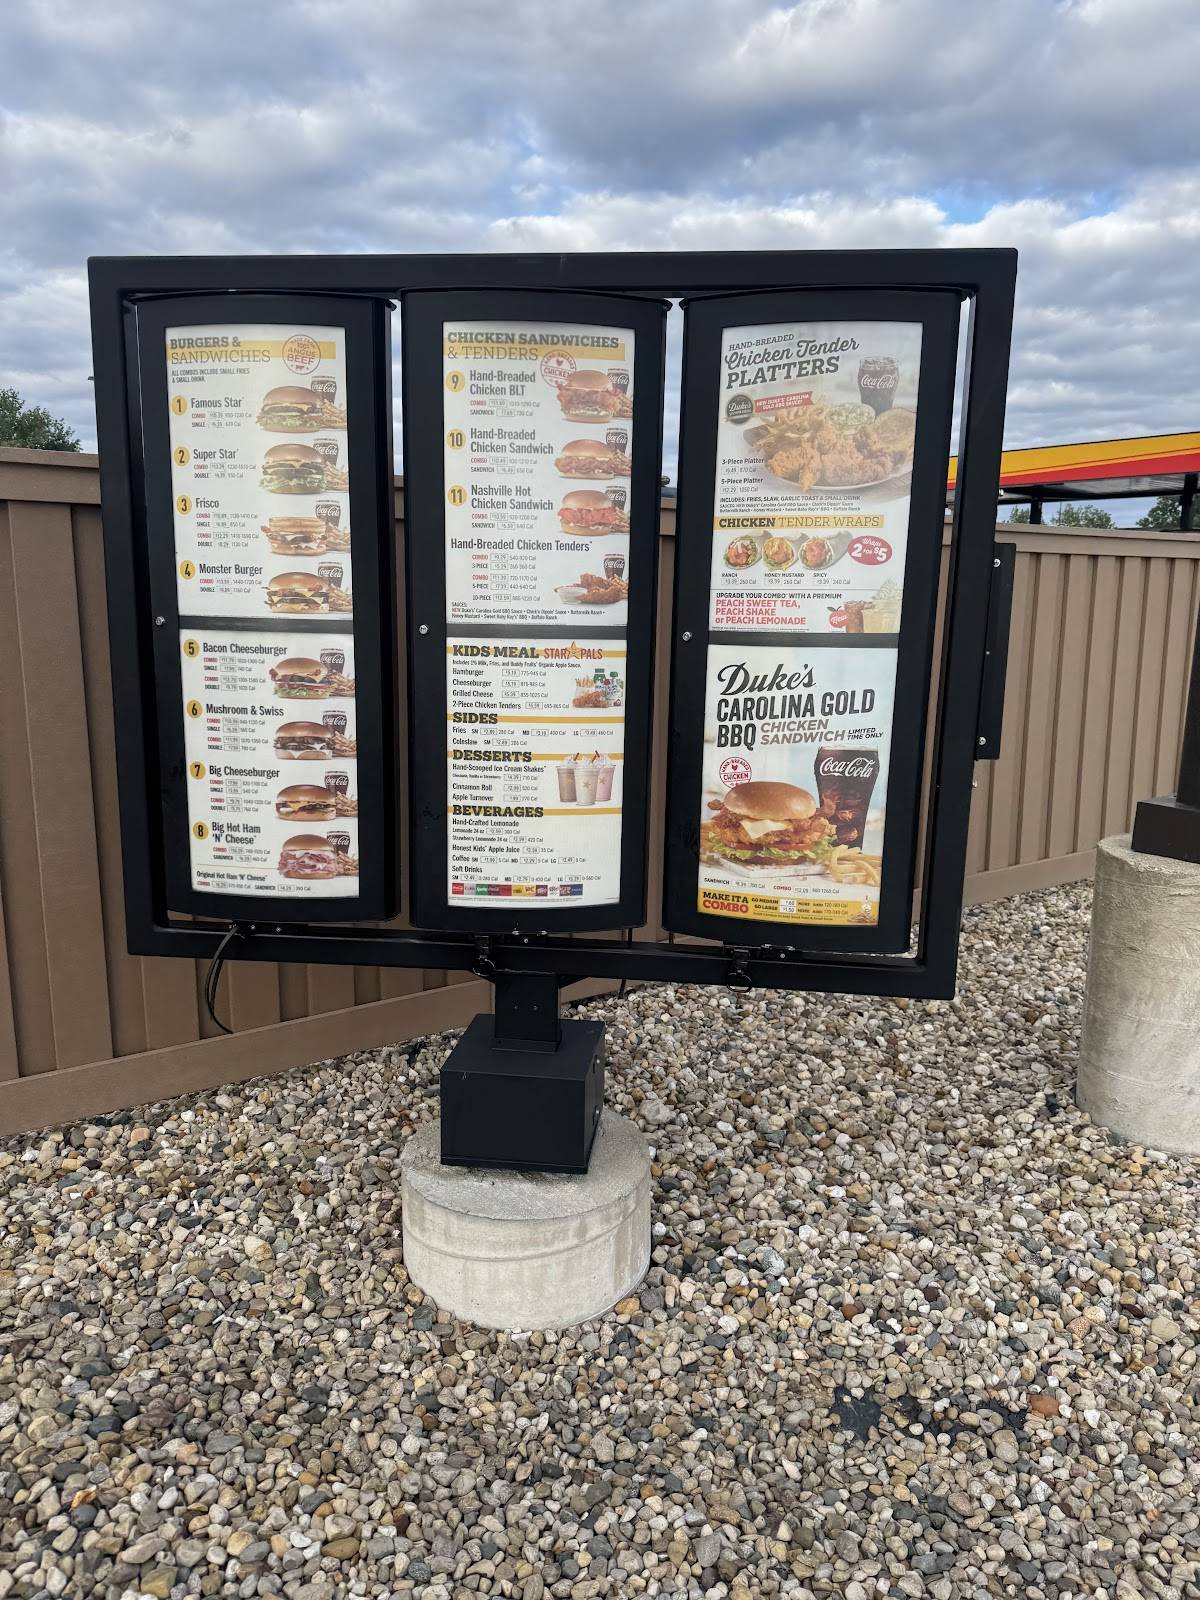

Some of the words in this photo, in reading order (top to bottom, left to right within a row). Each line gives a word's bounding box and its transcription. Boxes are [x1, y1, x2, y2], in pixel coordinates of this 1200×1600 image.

[170, 337, 229, 349] BURGERS
[232, 336, 241, 347] &
[448, 332, 515, 344] CHICKEN
[518, 333, 619, 348] SANDWICHES
[729, 334, 794, 351] HAND-BREADED
[171, 350, 271, 364] SANDWICHES
[287, 354, 314, 364] BEEF
[448, 347, 457, 358] &
[462, 346, 538, 361] TENDERS
[725, 348, 793, 369] Chicken
[796, 338, 859, 358] Tender
[470, 371, 535, 382] Hand-Breaded
[726, 356, 839, 389] PLATTERS
[452, 375, 458, 389] 9
[861, 374, 896, 389] Coca-Cola
[470, 384, 506, 396] Chicken
[509, 385, 525, 396] BLT
[177, 398, 182, 412] 1
[191, 398, 222, 409] Famous
[225, 397, 242, 408] Star
[729, 402, 752, 412] Duke's
[450, 433, 462, 447] 10
[470, 428, 535, 440] Hand-Breaded
[471, 442, 506, 453] Chicken
[509, 443, 553, 454] Sandwich
[179, 450, 185, 463] 2
[193, 449, 216, 461] Super
[219, 448, 236, 459] Star
[450, 489, 463, 503] 11
[471, 485, 512, 496] Nashville
[515, 486, 531, 496] Hot
[181, 498, 187, 512] 3
[196, 498, 219, 509] Frisco
[471, 498, 507, 509] Chicken
[510, 499, 553, 510] Sandwich
[719, 518, 776, 527] CHICKEN
[780, 517, 830, 527] TENDER
[834, 516, 879, 526] WRAPS
[451, 539, 514, 550] Hand-Breaded
[517, 540, 552, 550] Chicken
[555, 541, 589, 551] Tenders
[851, 543, 862, 558] 2
[874, 547, 888, 561] $5
[185, 564, 190, 577] 4
[199, 564, 232, 574] Monster
[235, 564, 263, 576] Burger
[780, 600, 800, 608] TEA,
[716, 608, 744, 616] PEACH
[746, 608, 776, 616] SHAKE
[757, 617, 806, 625] LEMONADE
[188, 642, 194, 655] 5
[203, 643, 227, 653] Bacon
[230, 643, 287, 656] Cheeseburger
[453, 645, 490, 658] KIDS
[494, 646, 539, 659] MEAL
[544, 648, 567, 660] STAR
[580, 649, 602, 660] PALS
[453, 668, 484, 677] Hamburger
[718, 662, 816, 695] Duke's
[453, 679, 492, 687] Cheeseburger
[472, 690, 493, 698] Cheese
[192, 702, 197, 716] 6
[206, 704, 248, 715] Mushroom
[251, 705, 257, 715] &
[259, 706, 284, 716] Swiss
[474, 701, 497, 709] Chicken
[499, 702, 521, 710] Tenders
[717, 694, 815, 722] CAROLINA
[821, 689, 875, 716] GOLD
[453, 712, 498, 724] SIDES
[717, 723, 756, 751] BBQ
[761, 719, 829, 733] CHICKEN
[760, 730, 846, 745] SANDWICH
[453, 750, 532, 762] DESSERTS
[194, 764, 201, 776] 7
[209, 766, 222, 776] Big
[224, 766, 280, 778] Cheeseburger
[453, 764, 492, 772] Hand-Scooped
[504, 765, 522, 773] Cream
[820, 757, 873, 778] Coca-Cola
[452, 783, 480, 791] Cinnamon
[452, 793, 468, 801] Apple
[452, 805, 543, 818] BEVERAGES
[212, 822, 224, 833] Big
[227, 823, 240, 833] Hot
[243, 824, 261, 833] Ham
[452, 818, 489, 826] Hand-Crafted
[491, 819, 519, 827] Lemonade
[197, 824, 204, 837] 8
[225, 835, 254, 844] Cheese
[489, 846, 504, 854] Apple
[452, 865, 463, 873] Soft
[704, 877, 730, 885] SANDWICH
[703, 891, 729, 900] MAKE
[703, 900, 749, 914] COMBO
